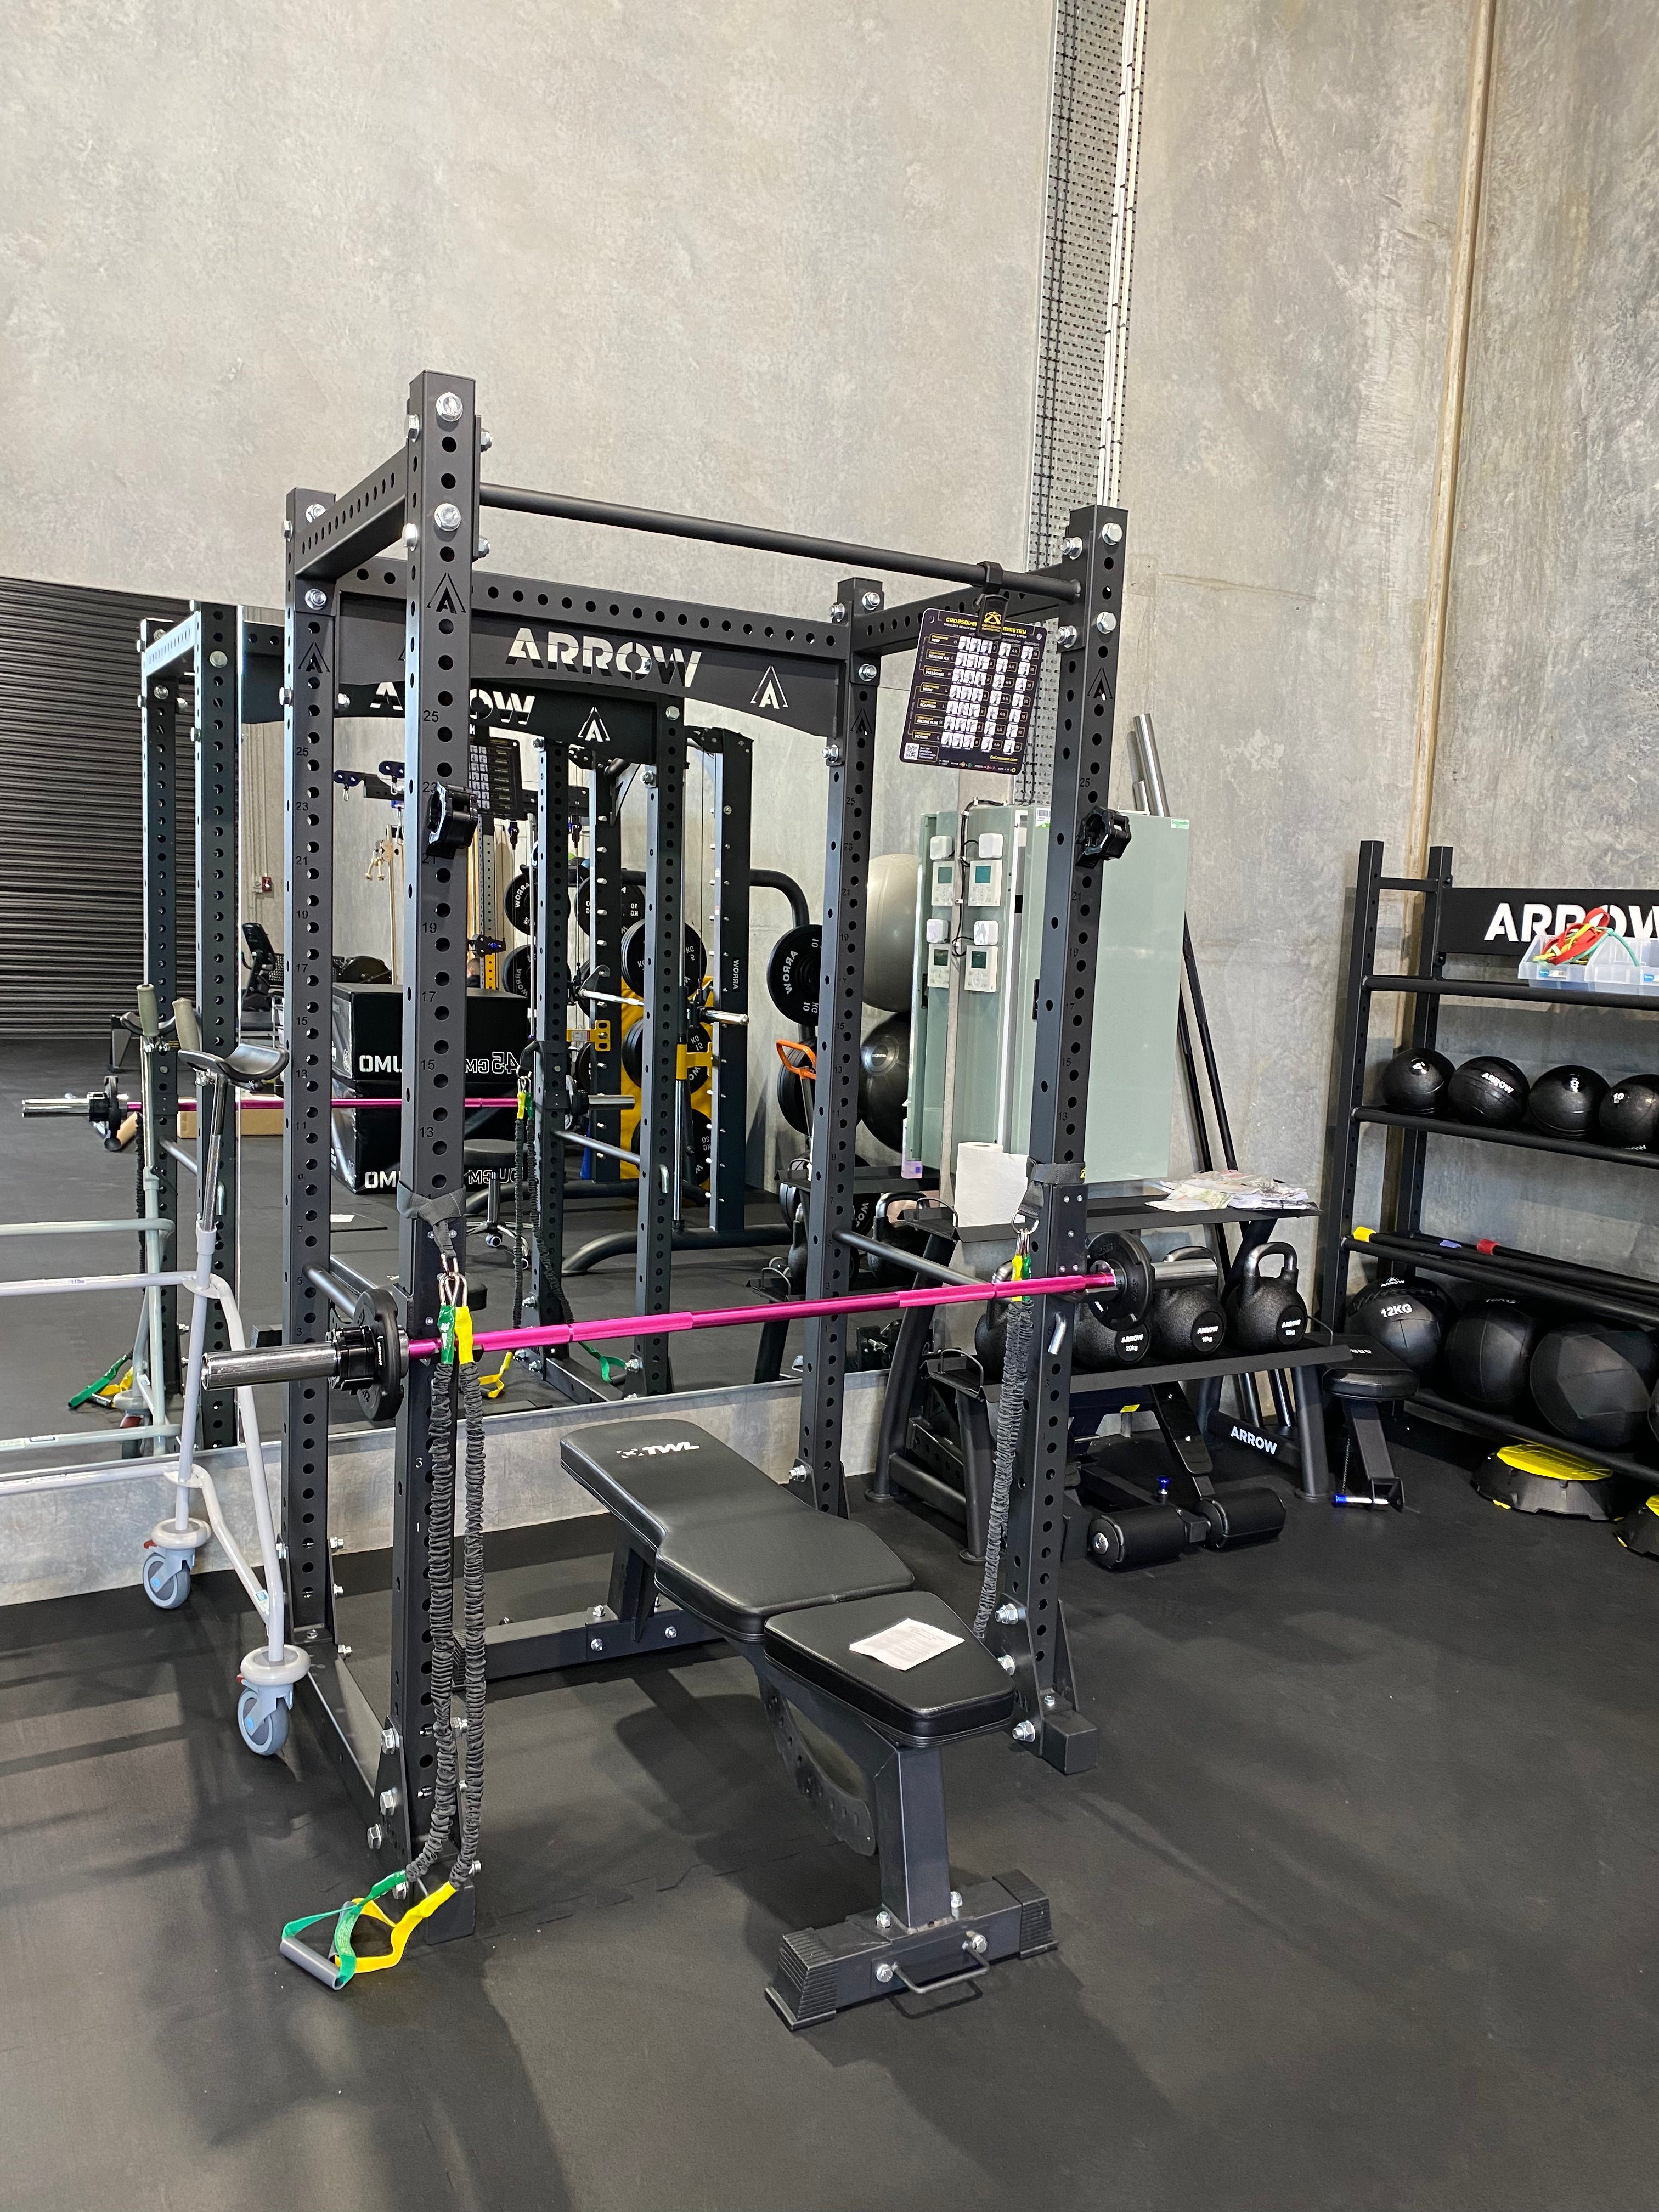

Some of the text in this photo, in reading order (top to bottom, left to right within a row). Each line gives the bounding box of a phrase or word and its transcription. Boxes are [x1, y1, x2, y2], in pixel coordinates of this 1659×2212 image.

[945, 617, 1027, 635] CROSSOVE MMETRY
[505, 627, 702, 688] ARROW
[370, 681, 535, 725] AOW
[423, 710, 439, 723] 25
[296, 747, 309, 757] 25
[1080, 777, 1090, 787] 25
[846, 797, 855, 805] 25
[296, 802, 308, 811] 23
[295, 856, 308, 865] 21
[1071, 891, 1082, 901] 21
[296, 910, 308, 919] 19
[422, 922, 437, 934] 19
[1069, 947, 1079, 957] 19
[296, 963, 308, 973] 17
[421, 991, 437, 1003] 17
[1065, 1003, 1075, 1012] 17
[296, 1017, 308, 1025] 15
[836, 1022, 844, 1030] 15
[421, 1059, 436, 1070] 15
[1062, 1058, 1071, 1066] 15
[296, 1069, 308, 1078] 13
[1481, 1072, 1514, 1094] ARROW
[1570, 1080, 1579, 1088] 8
[1613, 1092, 1625, 1101] 10
[1058, 1112, 1068, 1121] 13
[296, 1121, 307, 1130] 11
[420, 1127, 435, 1138] 13
[297, 1277, 302, 1285] 5
[1381, 1279, 1405, 1288] ARROW
[1380, 1304, 1413, 1318] 12KG
[1281, 1319, 1301, 1328] ARROW
[296, 1327, 302, 1336] 3
[1197, 1325, 1219, 1334] ARROW
[1121, 1334, 1144, 1344] ARROW
[1230, 1426, 1278, 1455] ARROW
[642, 1441, 700, 1455] TWL
[415, 1457, 422, 1468] 3
